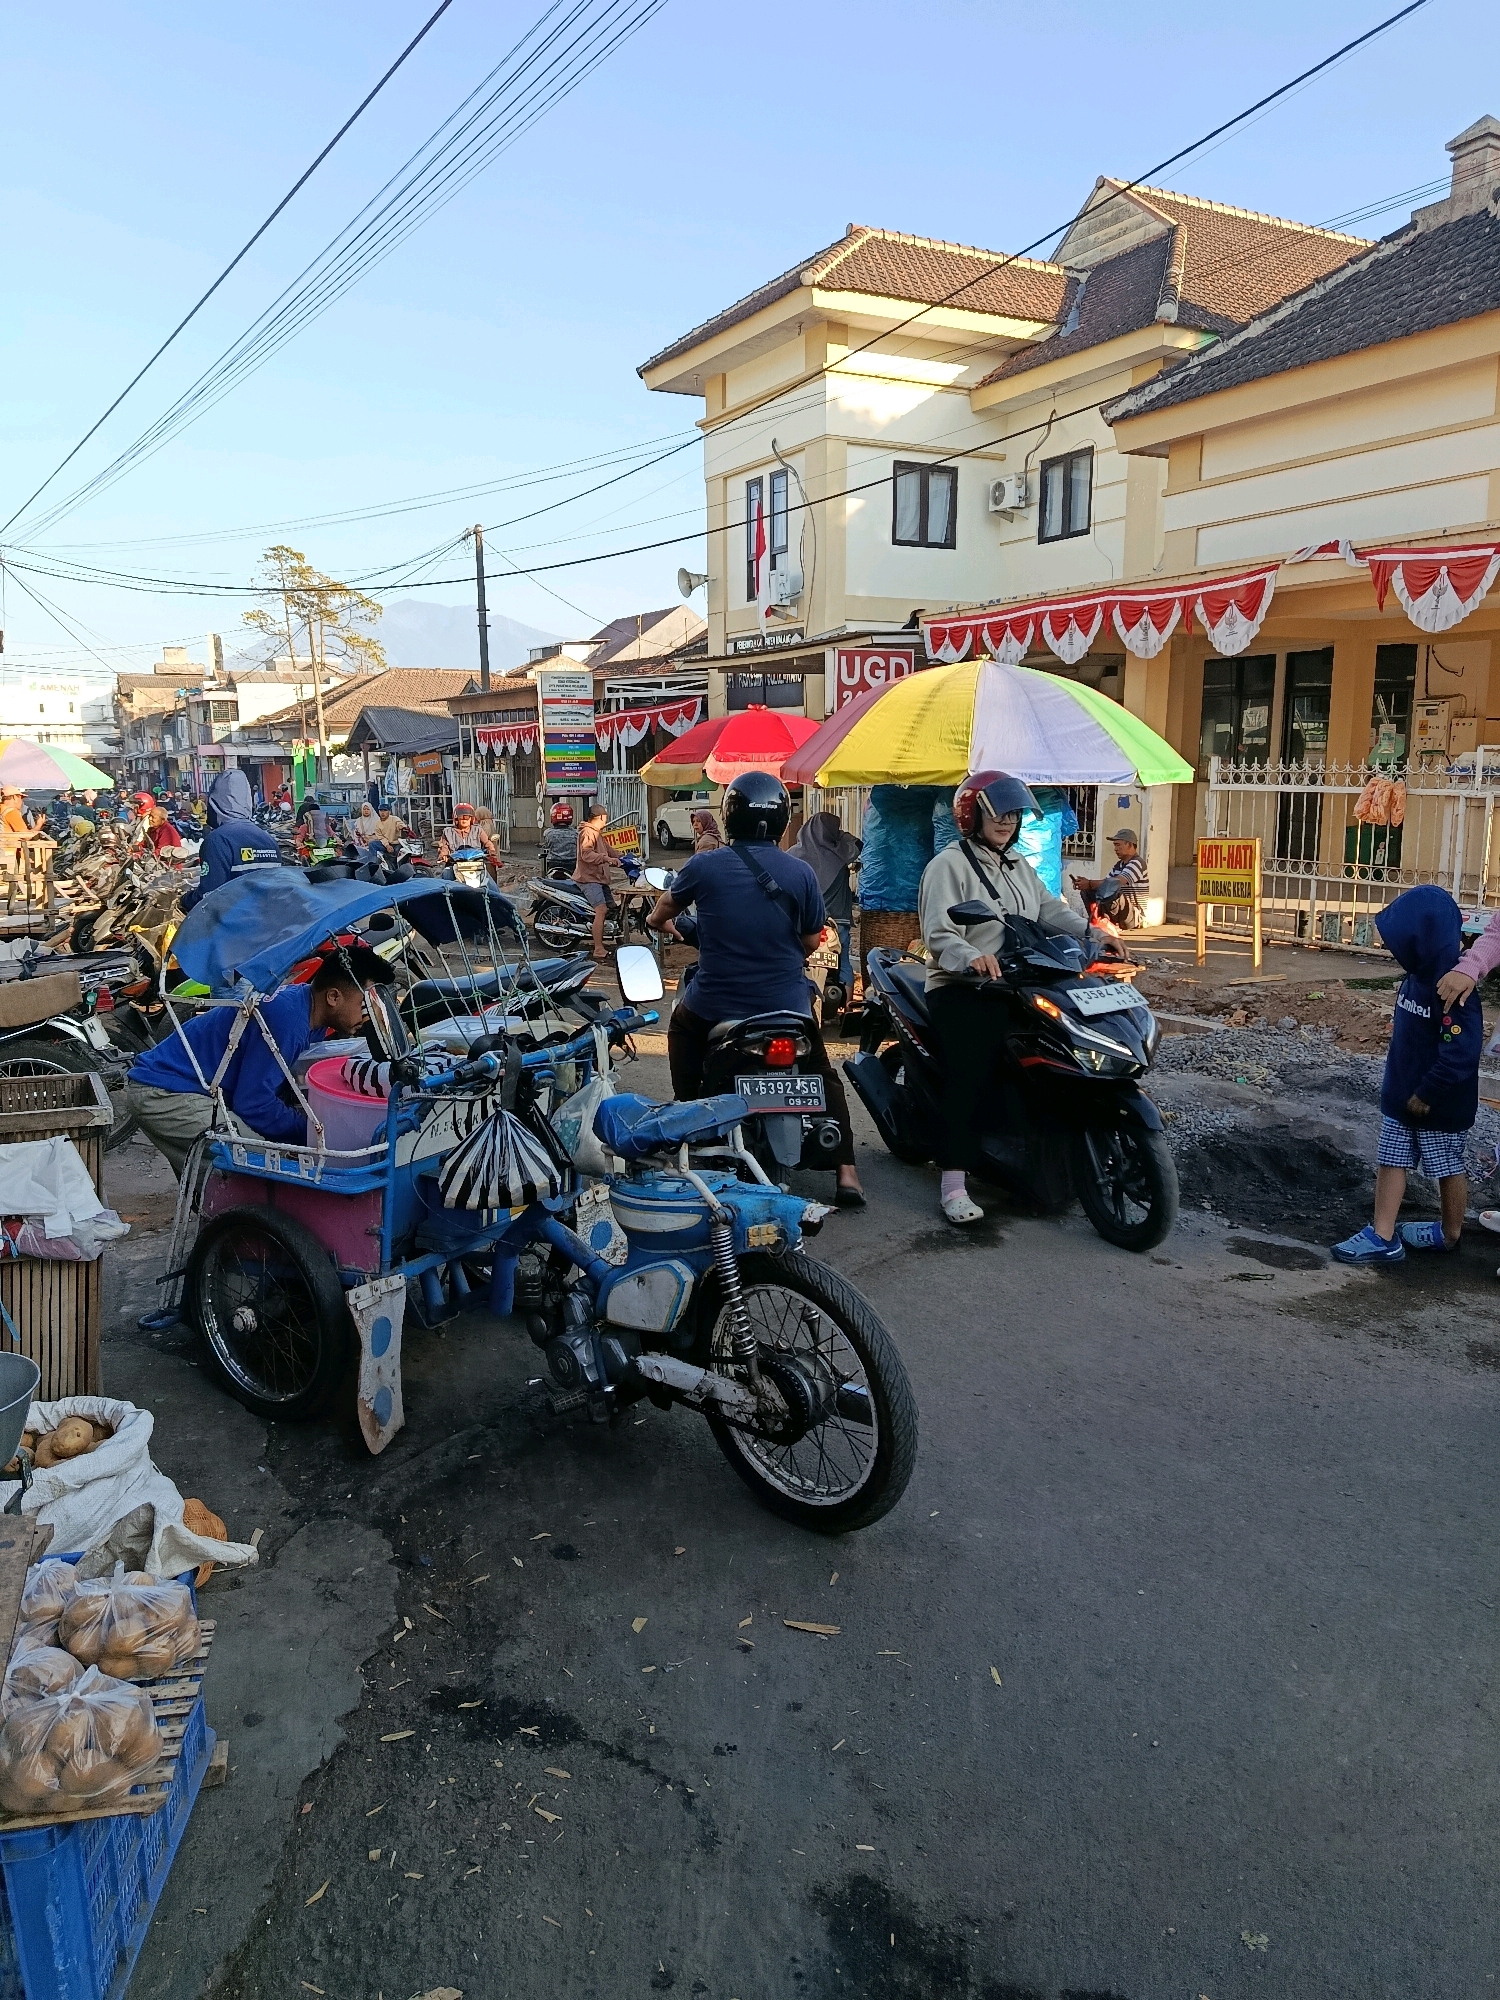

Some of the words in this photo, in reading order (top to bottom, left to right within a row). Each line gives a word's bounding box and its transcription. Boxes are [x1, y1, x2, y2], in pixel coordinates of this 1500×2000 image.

[841, 656, 909, 688] UGD
[40, 684, 80, 693] AMENAH
[842, 690, 863, 708] 2
[604, 829, 637, 846] TI-HATI
[1200, 844, 1253, 869] HATI-HATI
[1200, 880, 1211, 896] ADA
[1212, 880, 1232, 897] ORANG
[1233, 881, 1252, 899] KERJA
[742, 1082, 752, 1096] N
[760, 1081, 795, 1096] 6392
[801, 1081, 818, 1096] SG
